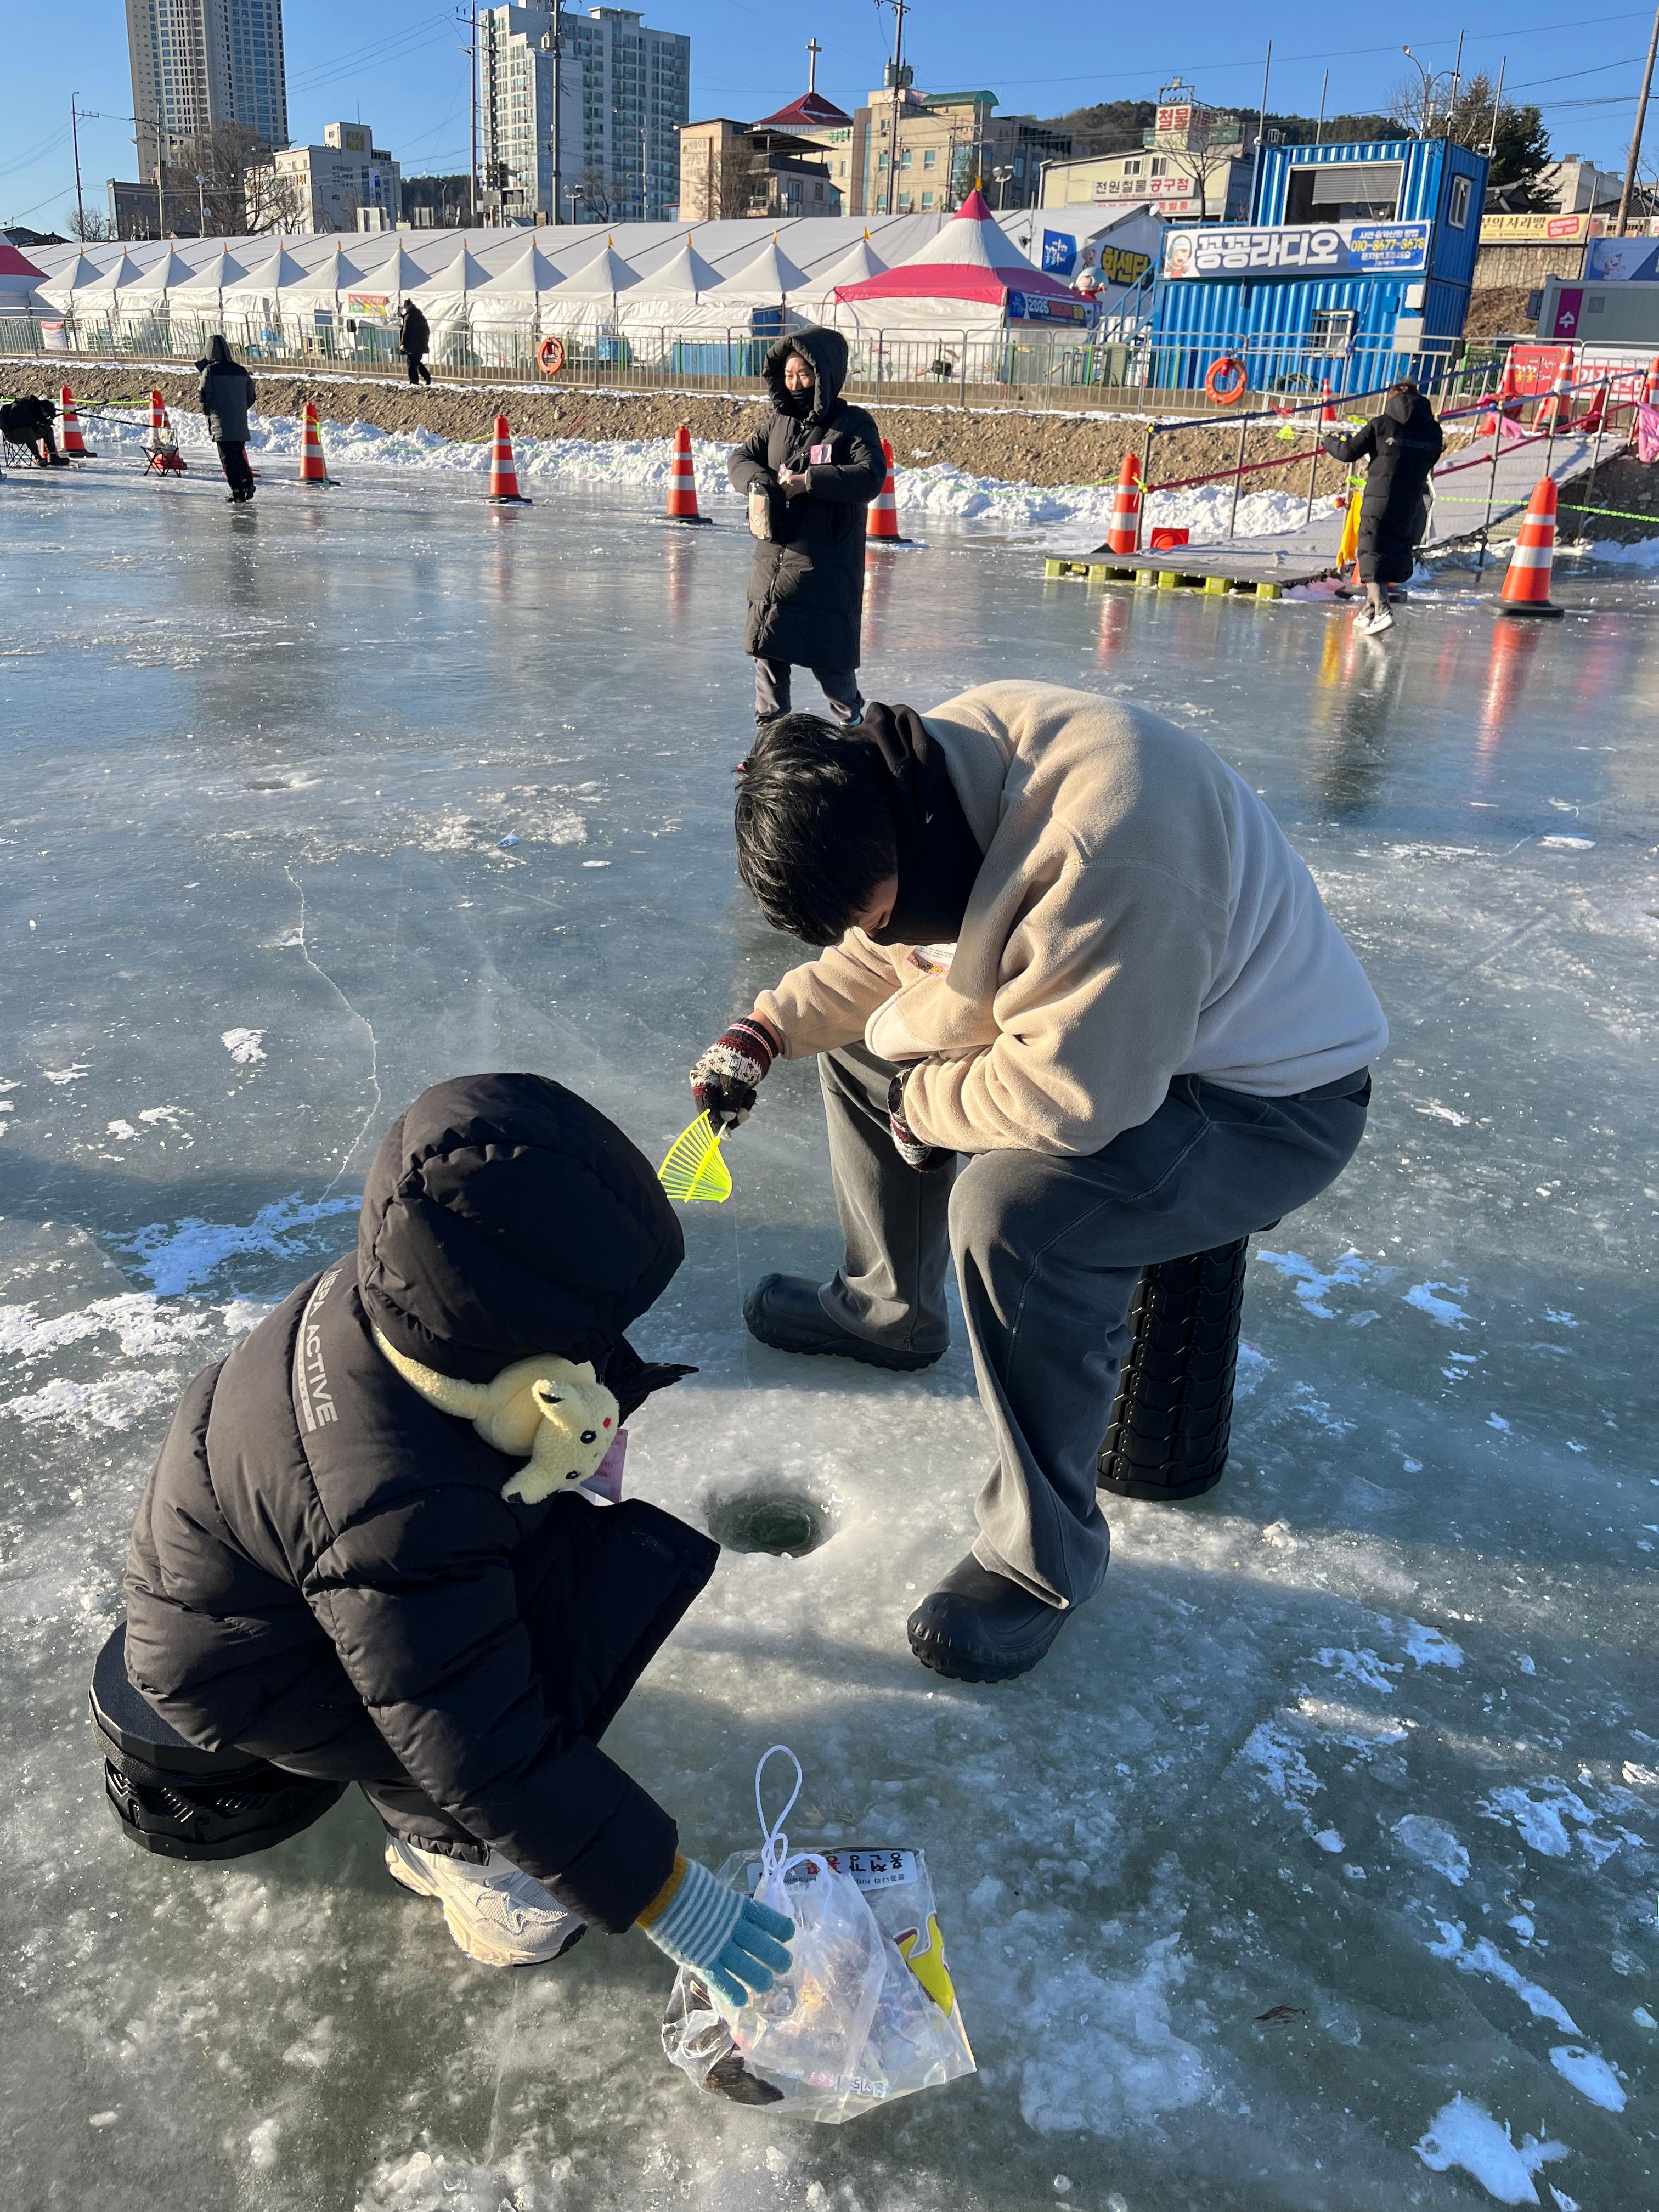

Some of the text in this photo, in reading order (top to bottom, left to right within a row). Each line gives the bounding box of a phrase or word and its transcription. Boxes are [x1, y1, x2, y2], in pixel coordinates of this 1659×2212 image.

[1159, 108, 1189, 131] 철물
[1096, 178, 1188, 194] 전원철물 공구점
[1197, 232, 1339, 269] 꽁꽁라디오
[1028, 297, 1050, 314] 2026
[309, 1268, 343, 1317] NEPA
[306, 1324, 338, 1427] ACTIVE
[849, 1853, 903, 1872] 홍천강
